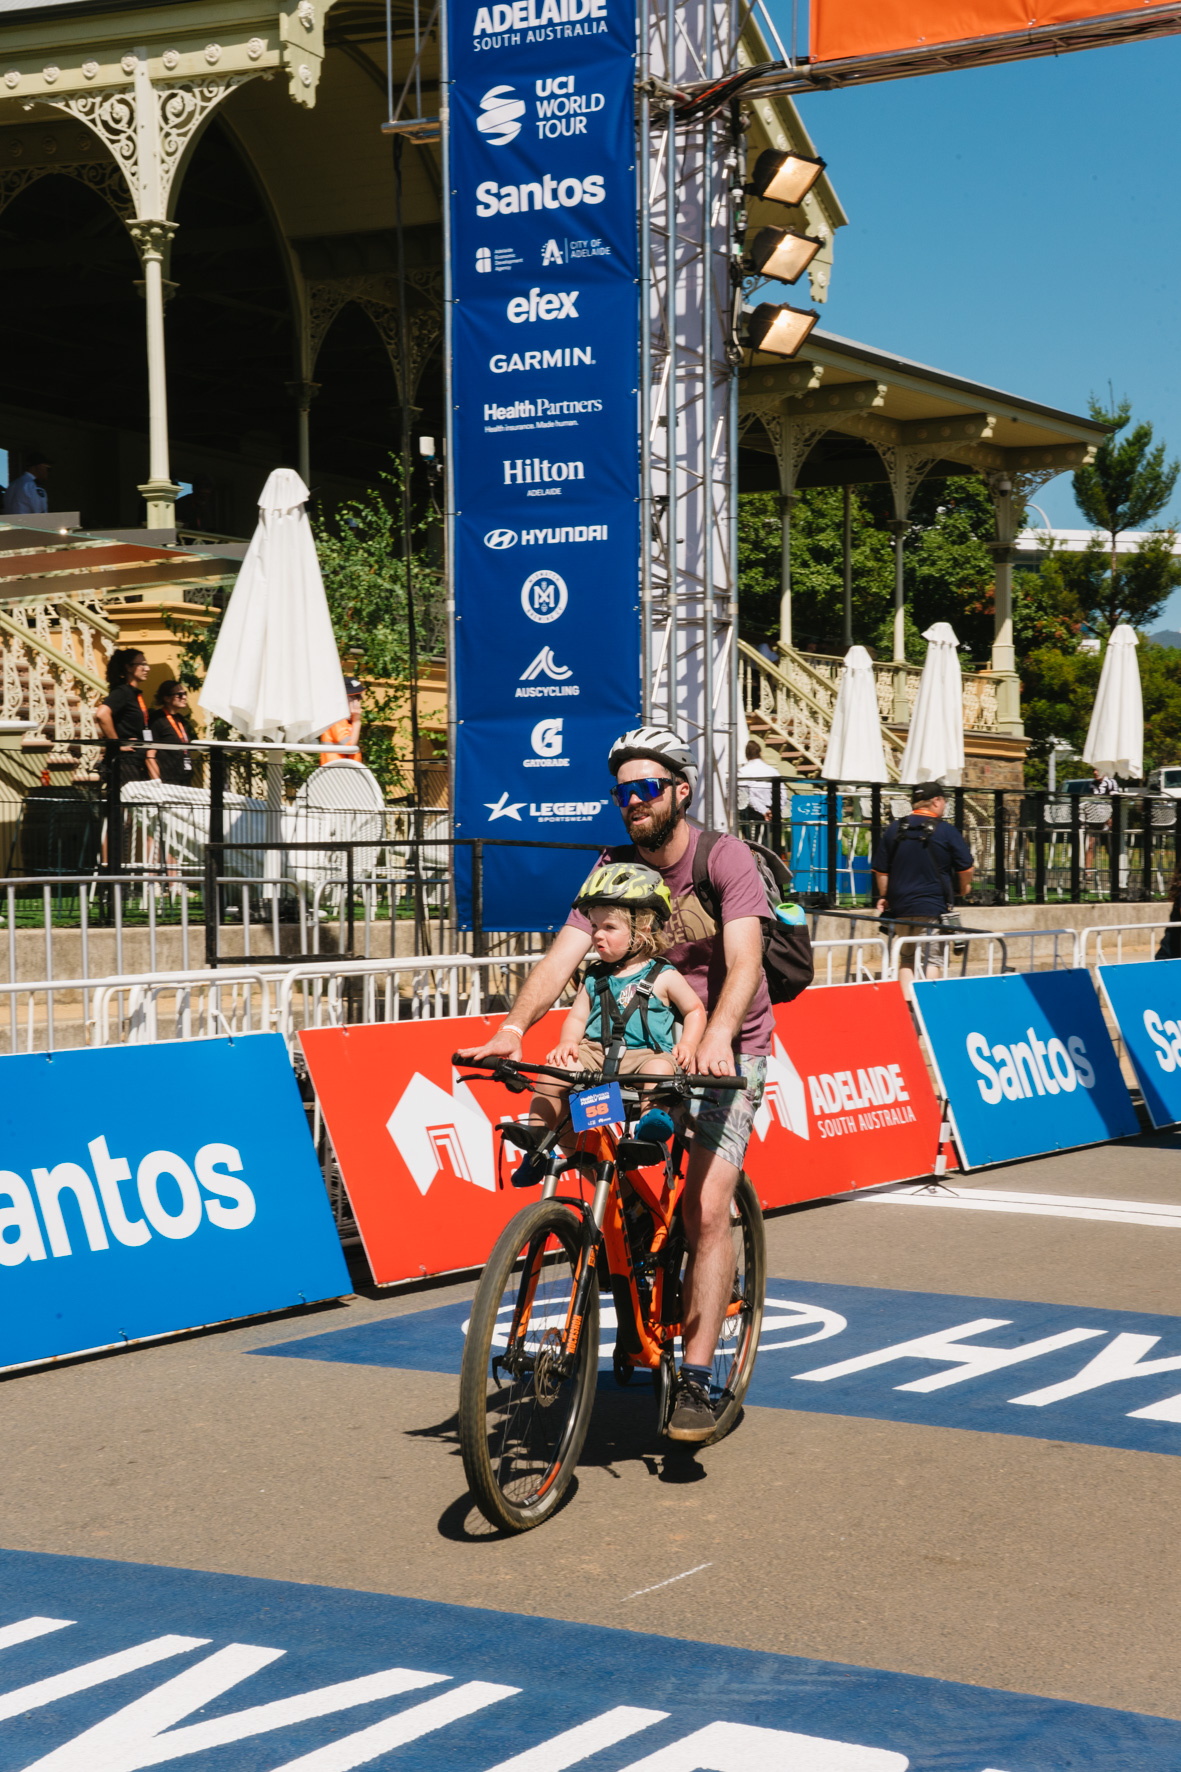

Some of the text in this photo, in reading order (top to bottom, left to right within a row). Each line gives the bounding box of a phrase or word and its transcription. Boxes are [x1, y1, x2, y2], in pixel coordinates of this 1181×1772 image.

[473, 0, 608, 36] ADELAIDE
[473, 20, 609, 52] SOUTH AUSTRALIA
[535, 75, 575, 97] UCI
[536, 93, 605, 118] WORLD
[536, 116, 588, 139] TOUR
[476, 174, 606, 217] Santos
[570, 238, 602, 250] CITY OF
[570, 246, 611, 258] ADELAIDE
[507, 287, 579, 323] efex
[503, 458, 585, 484] Hilton
[527, 487, 562, 497] ADELAIDE
[521, 525, 608, 545] HYUNDAI
[515, 685, 580, 698] AUSCYCLING
[523, 758, 570, 767] GATORADE
[529, 802, 602, 816] LEGEND
[538, 815, 593, 823] SPORTSWEAR
[966, 1027, 1096, 1105] Santos
[807, 1063, 911, 1116] ADELAIDE
[585, 1102, 609, 1118] 58
[817, 1105, 917, 1139] SOUTH AUSTRALIA
[0, 1135, 256, 1267] antos
